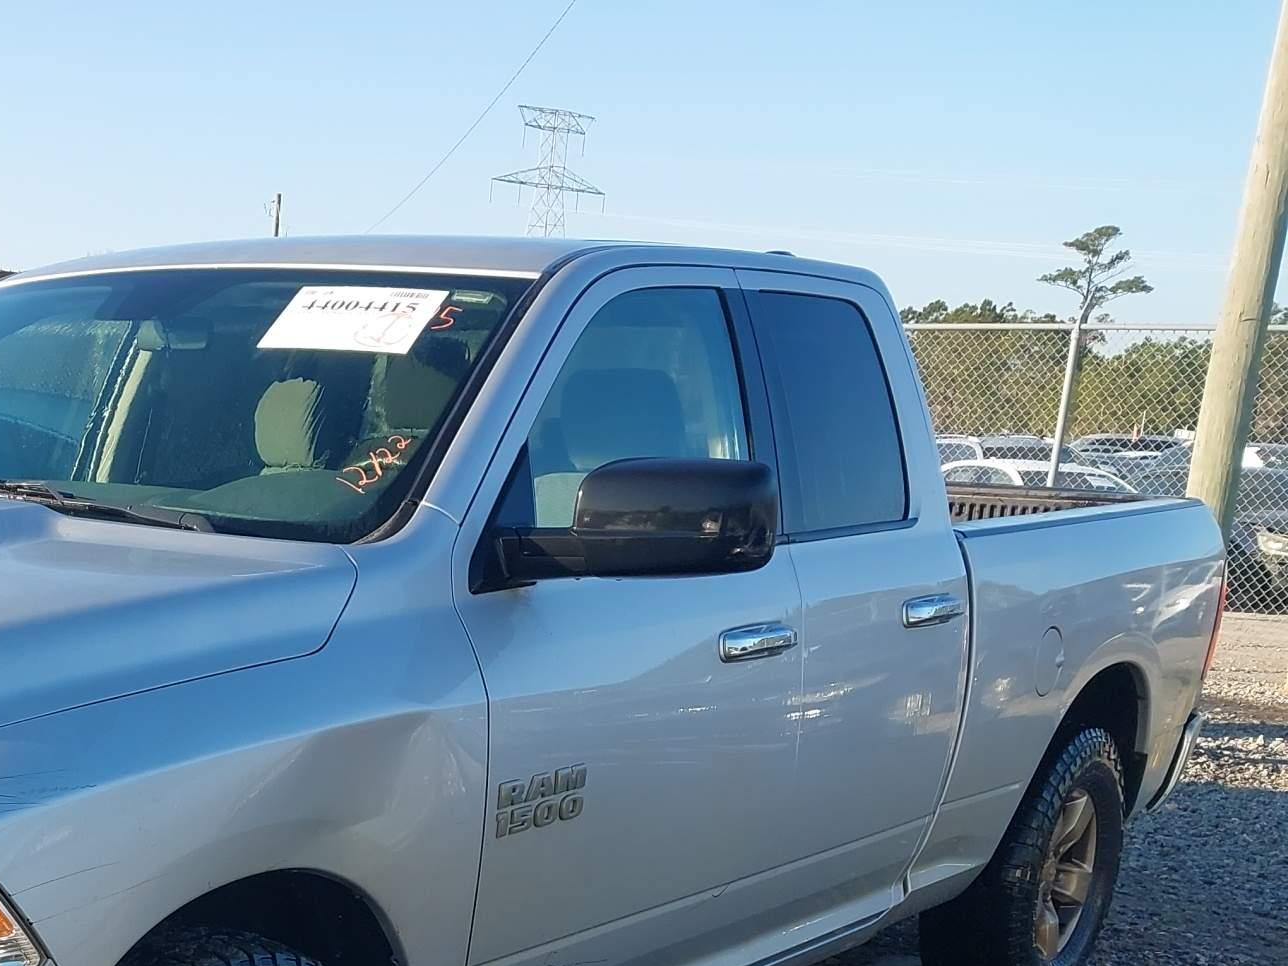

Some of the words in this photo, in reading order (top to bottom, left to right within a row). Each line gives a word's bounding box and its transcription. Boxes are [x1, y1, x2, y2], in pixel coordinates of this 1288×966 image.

[301, 298, 420, 313] 44004415
[497, 762, 587, 810] RAM
[495, 792, 584, 839] 1500
